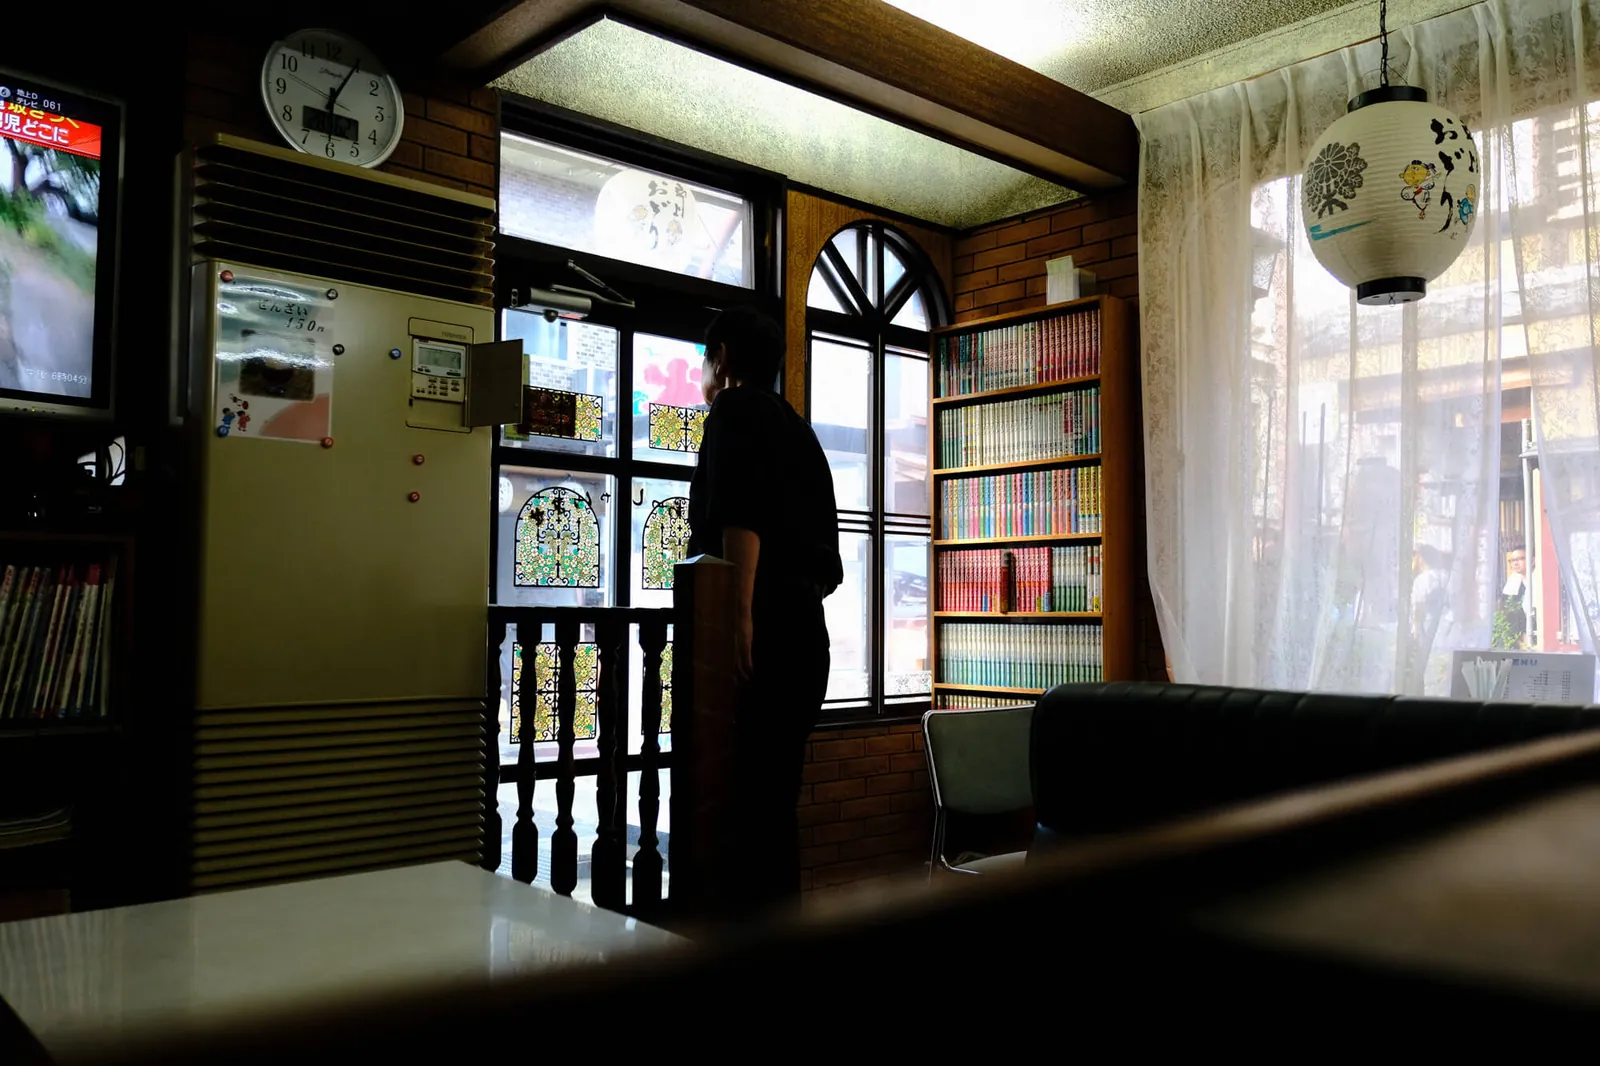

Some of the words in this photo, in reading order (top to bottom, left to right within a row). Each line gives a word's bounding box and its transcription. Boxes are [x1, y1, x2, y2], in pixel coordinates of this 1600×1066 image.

[302, 41, 315, 59] 11
[326, 42, 341, 60] 12
[281, 53, 298, 72] 10
[17, 88, 38, 100] 地上D
[276, 77, 287, 94] 9
[369, 80, 379, 97] 2
[16, 96, 38, 109] テレビ
[43, 99, 61, 112] 061
[282, 105, 292, 122] 8
[375, 106, 384, 122] 3
[0, 111, 69, 144] 児どこに
[301, 128, 310, 145] 7
[368, 129, 377, 145] 4
[325, 141, 335, 158] 6
[350, 142, 359, 157] 5
